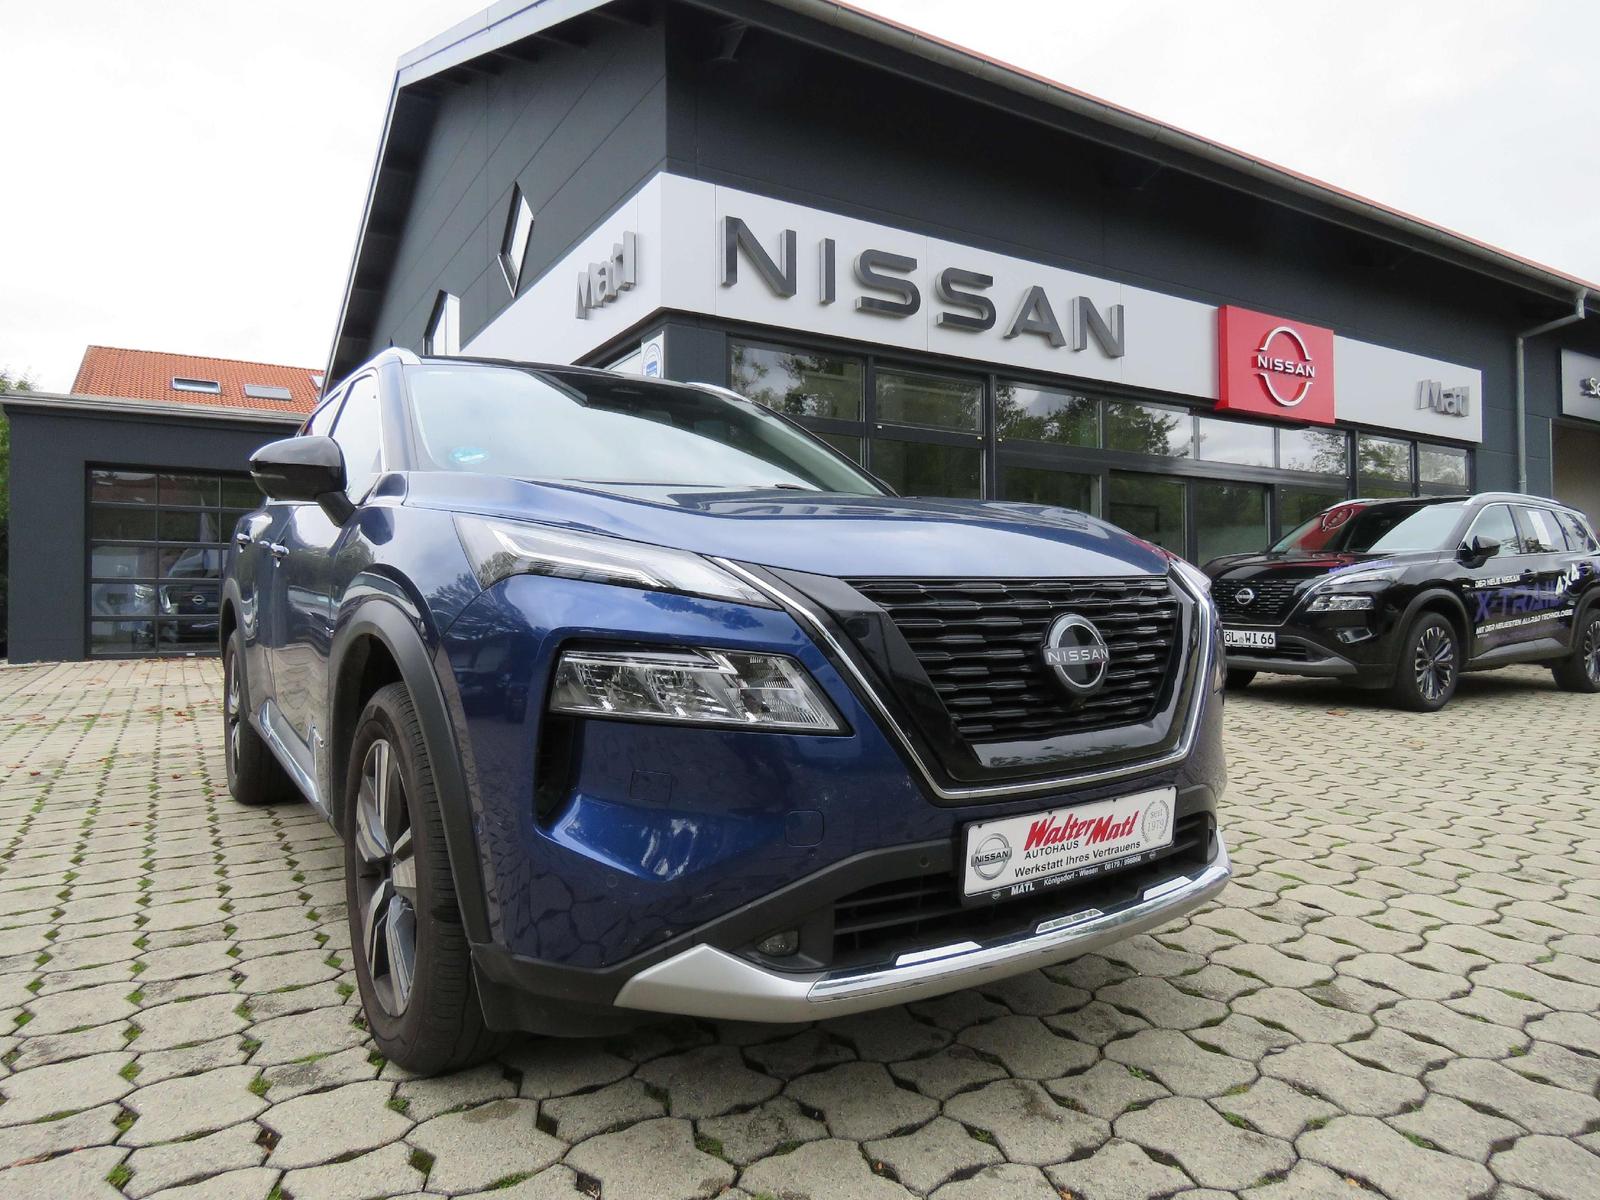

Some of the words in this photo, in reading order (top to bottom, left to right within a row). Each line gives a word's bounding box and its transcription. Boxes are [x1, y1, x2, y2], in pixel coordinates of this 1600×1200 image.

[575, 231, 637, 320] Matl
[721, 216, 1125, 359] NISSAN
[1257, 355, 1315, 378] NISSAN
[1475, 579, 1487, 588] DER
[1487, 577, 1504, 586] NEUE
[1504, 575, 1521, 584] NISSAN
[1245, 633, 1257, 644] WI
[1260, 634, 1274, 645] 66
[1047, 648, 1109, 662] NISSAN
[1024, 813, 1096, 851] Walter
[1085, 810, 1140, 846] Matl
[975, 850, 1009, 864] NISSAN
[1014, 859, 1064, 878] Werkstatt
[1066, 851, 1090, 866] Ihres
[1092, 841, 1141, 860] Vertrauens
[1024, 840, 1079, 860] AUTOHAUS
[1011, 882, 1035, 895] MATL
